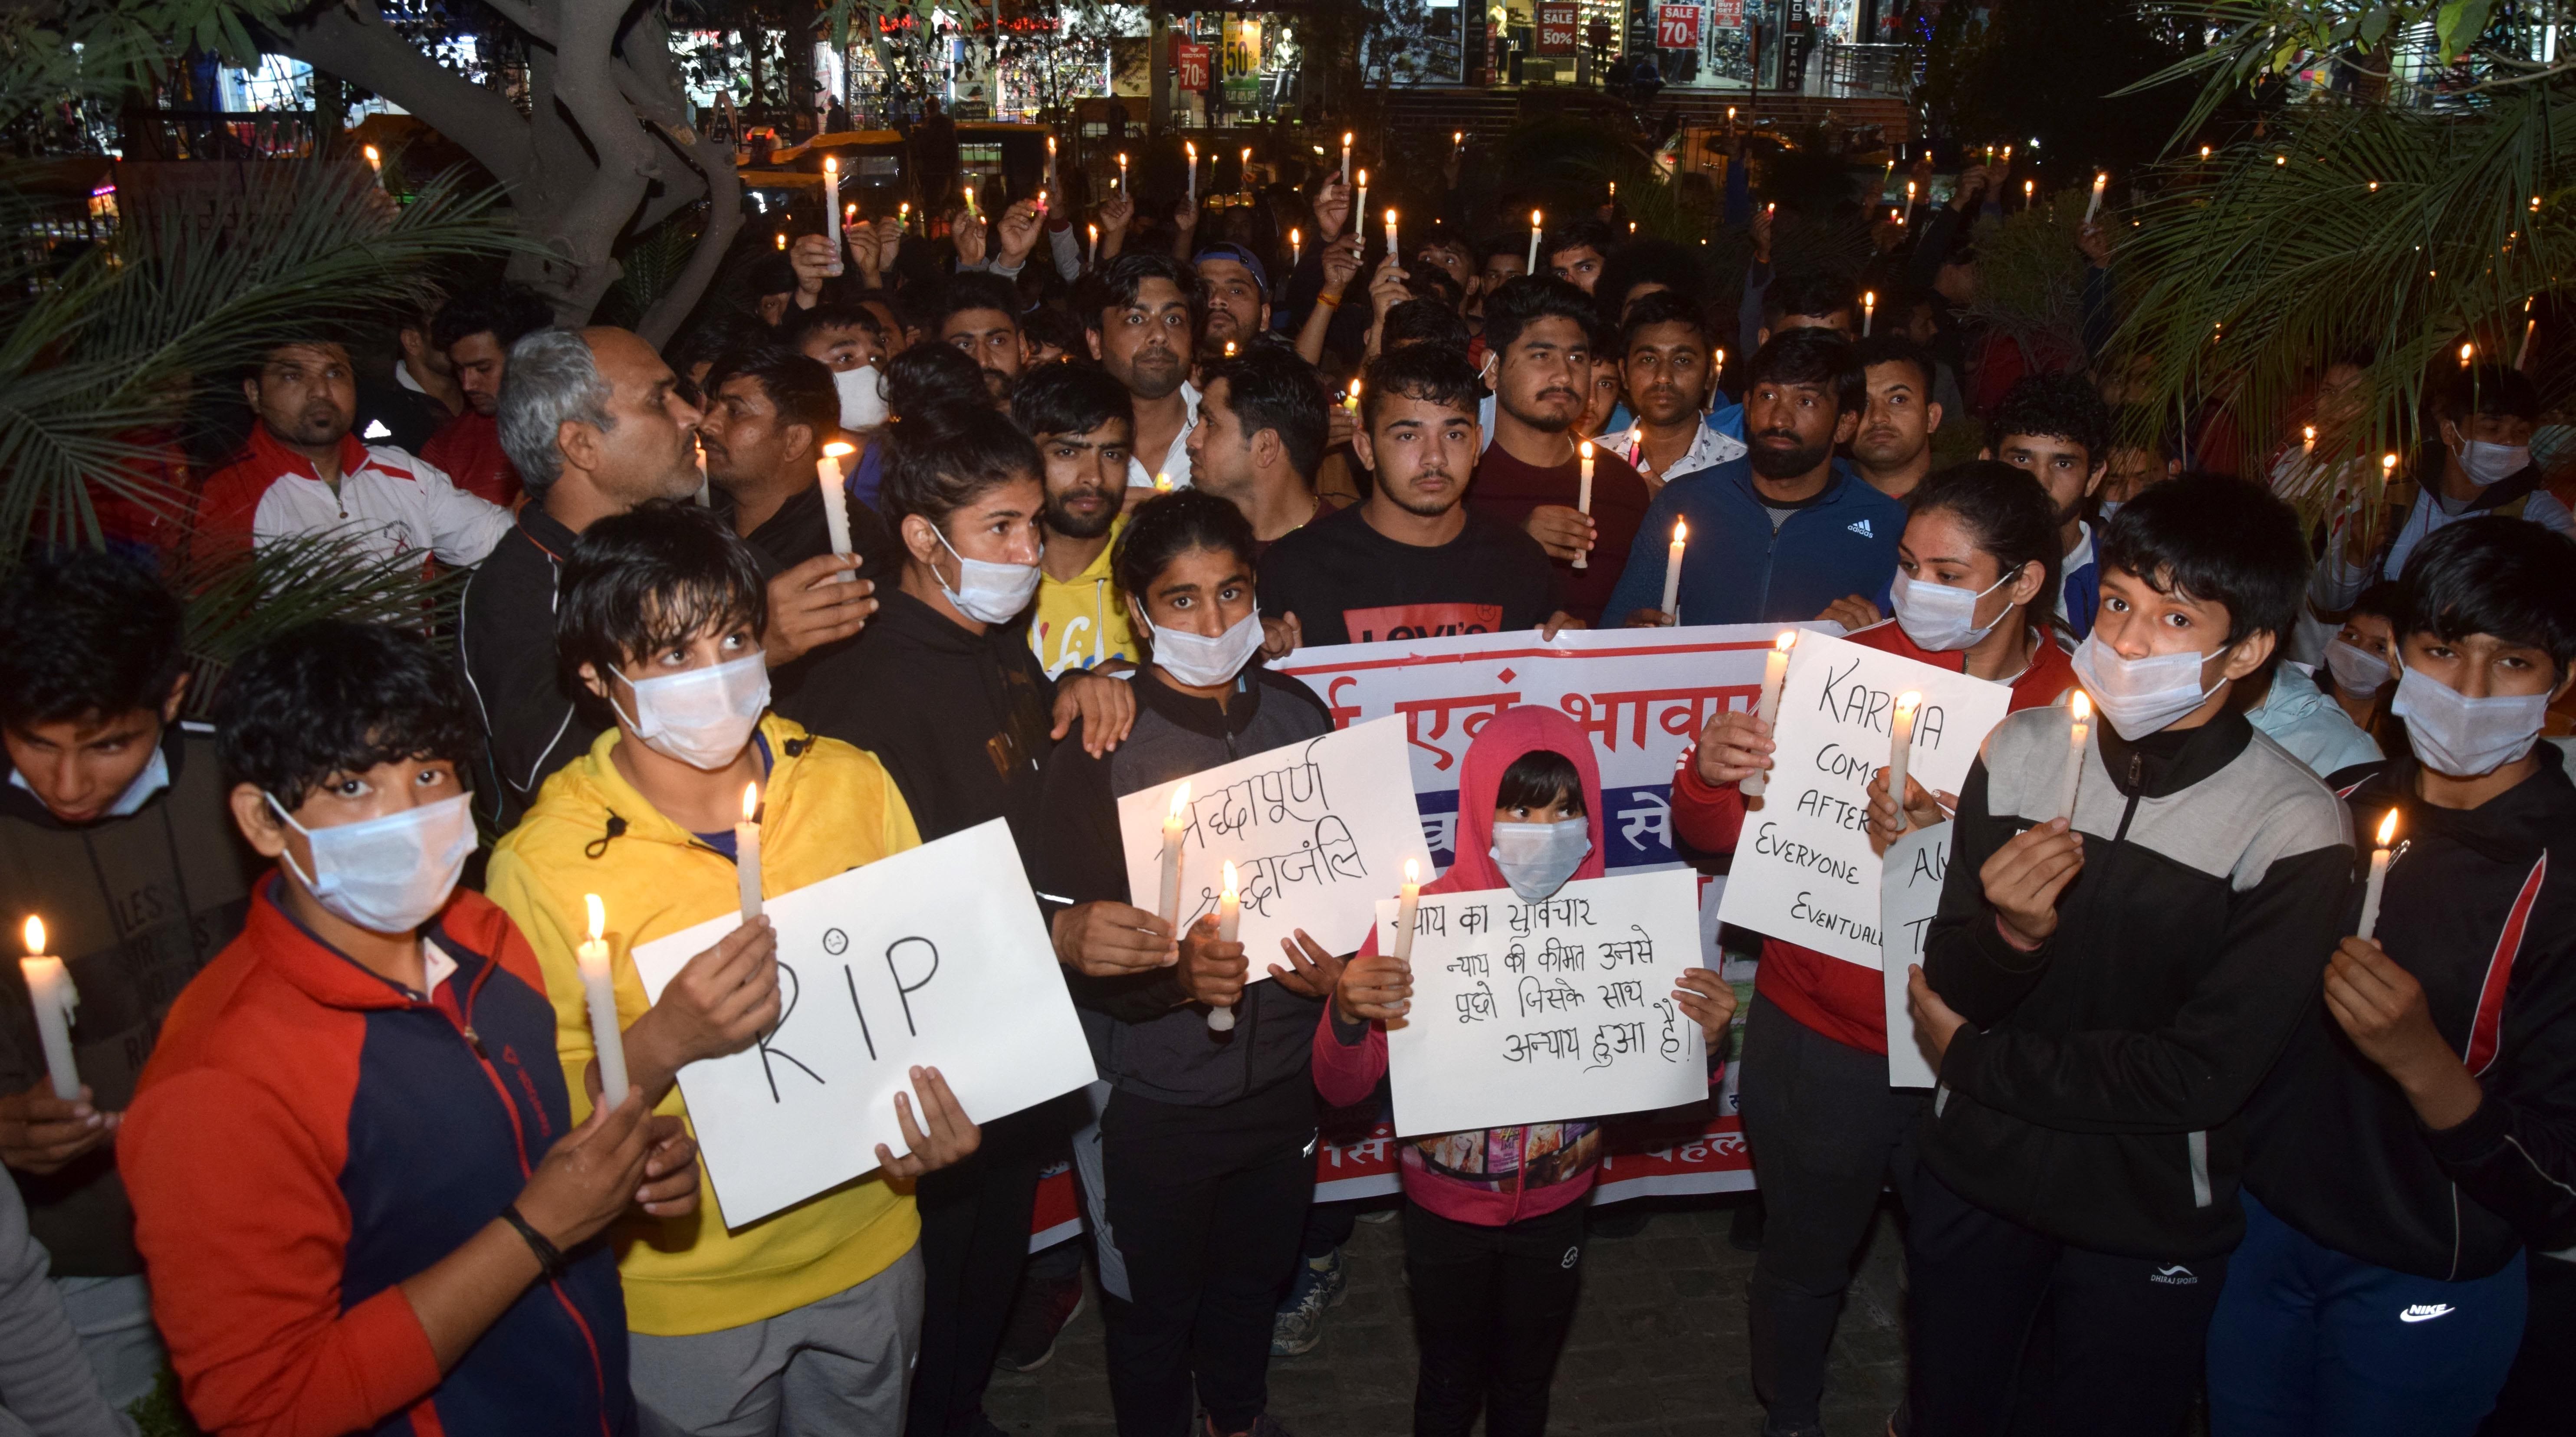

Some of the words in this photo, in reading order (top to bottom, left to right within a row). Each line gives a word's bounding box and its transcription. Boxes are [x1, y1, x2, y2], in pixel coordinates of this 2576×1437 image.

[1544, 13, 1573, 24] SALE
[1665, 7, 1693, 18] SALE
[1543, 32, 1572, 45] 50%
[1226, 90, 1236, 102] FLAT
[1247, 90, 1257, 102] OFF
[1847, 525, 1873, 538] adidas
[1797, 789, 1871, 834] AFTER
[1756, 822, 1859, 885] EVERYONE
[1459, 905, 1488, 935] का
[1446, 953, 1489, 977] न्याय
[1538, 937, 1584, 972] कीमत
[1598, 925, 1653, 970] उनसे
[1518, 976, 1585, 1017] जिसके
[1597, 979, 1645, 1007] साथ
[1503, 1027, 1580, 1063] अन्याय
[1583, 1021, 1645, 1073] हुआ
[2151, 1274, 2175, 1284] DHIRAJ
[2177, 1276, 2198, 1285] SPORTS
[2409, 1303, 2447, 1315] NIKE
